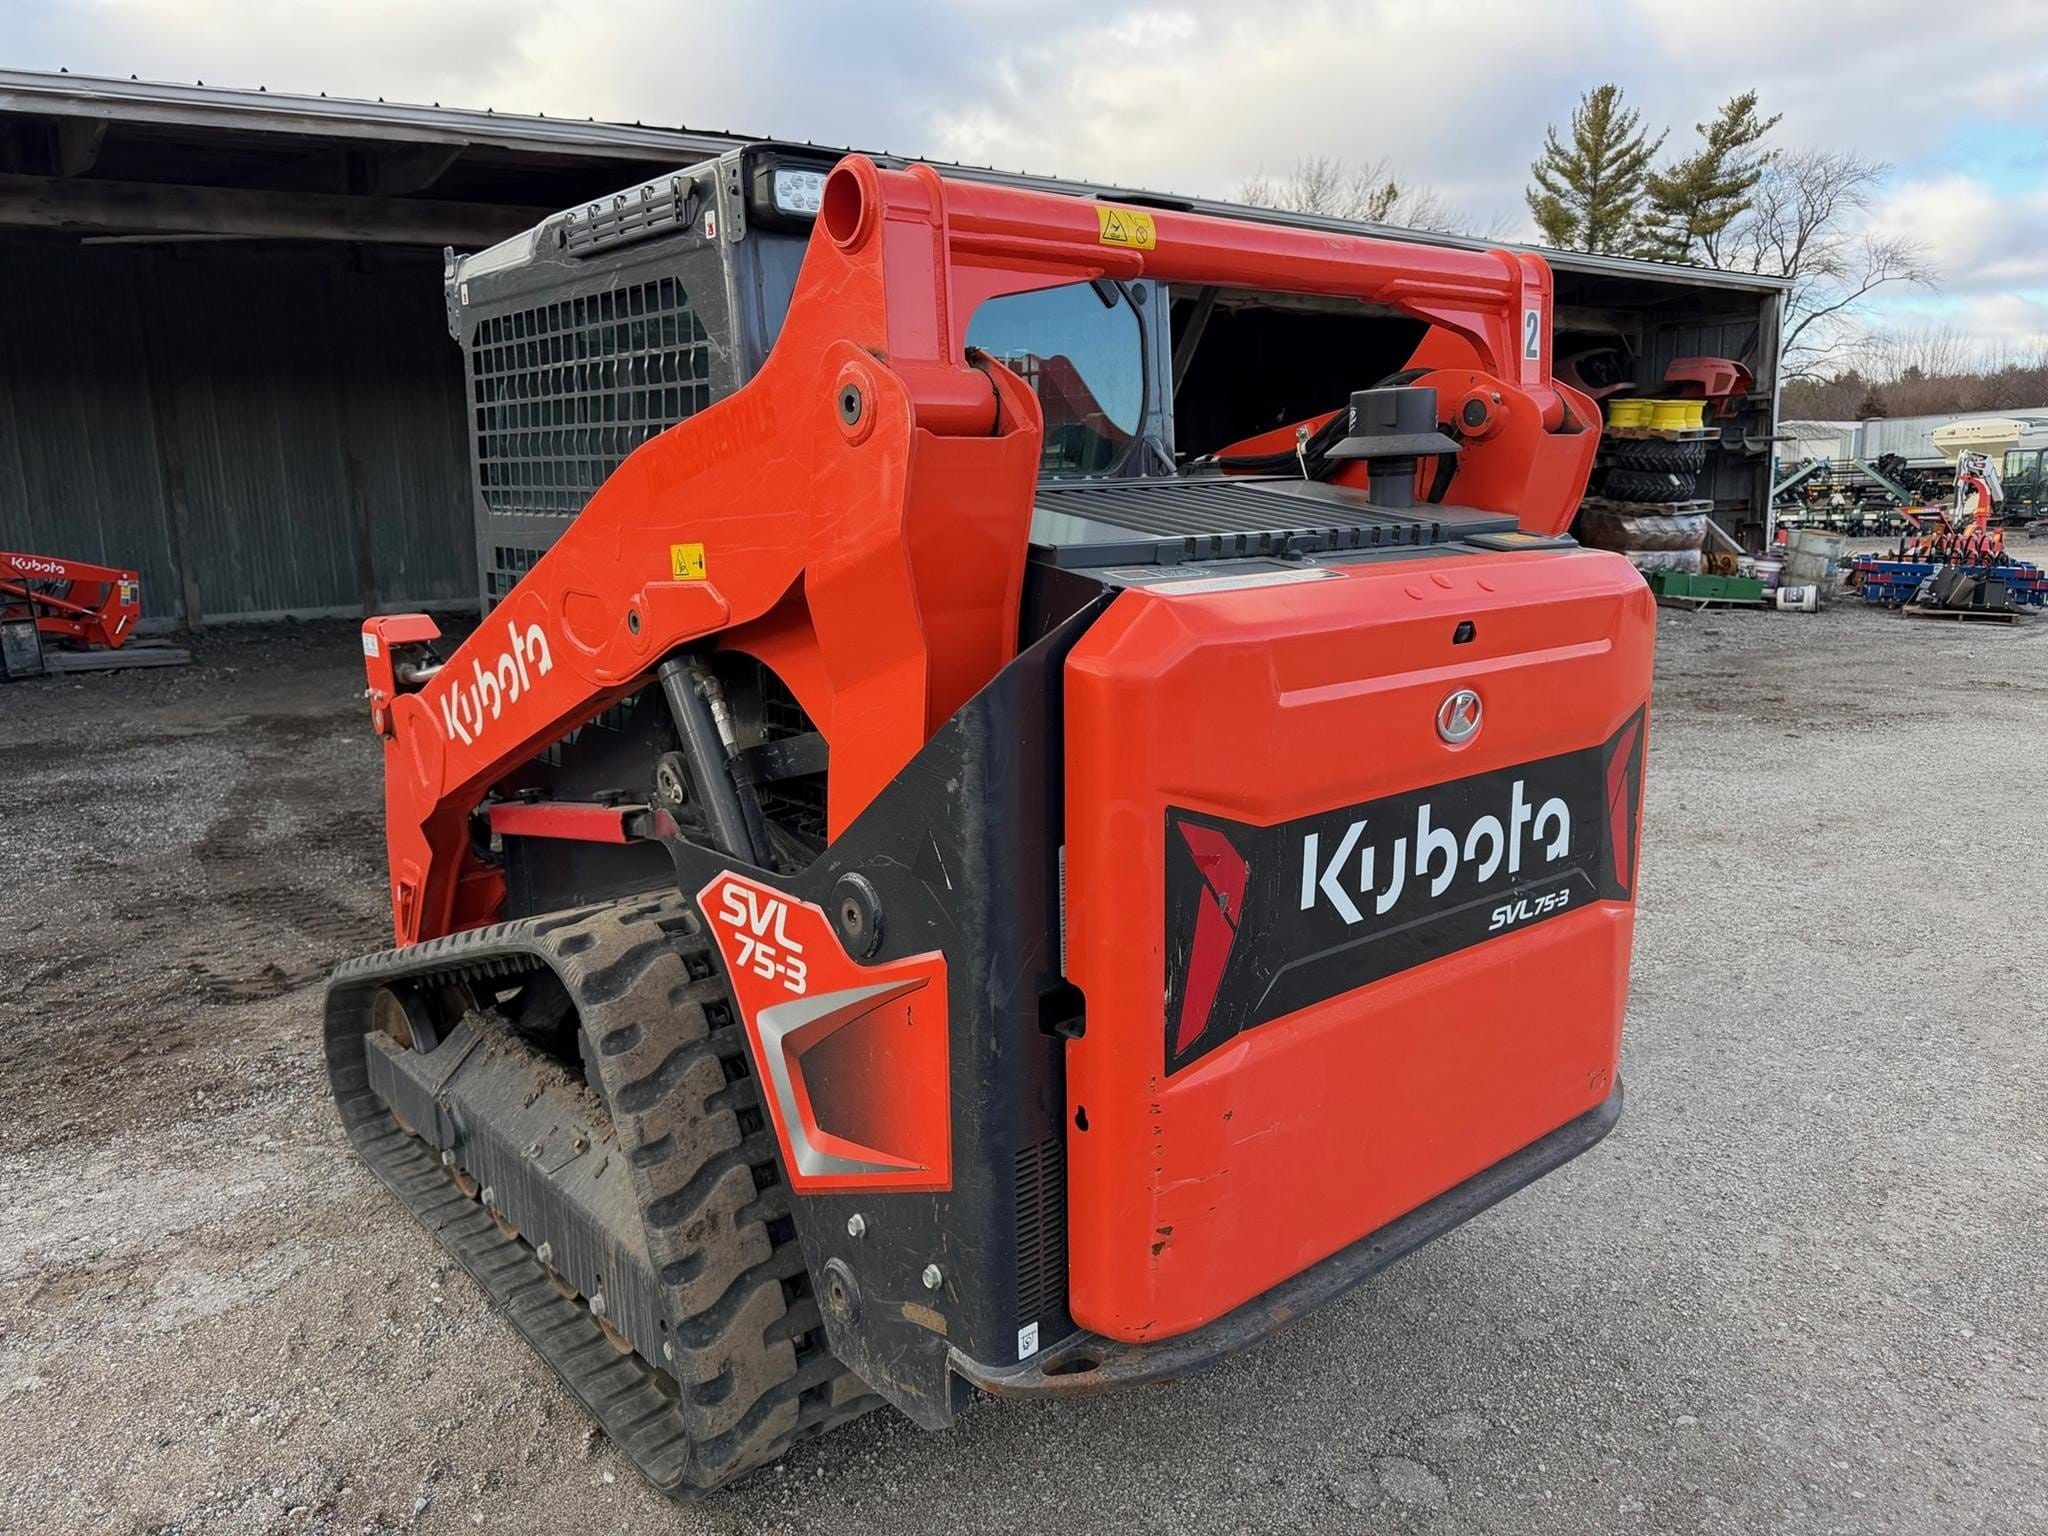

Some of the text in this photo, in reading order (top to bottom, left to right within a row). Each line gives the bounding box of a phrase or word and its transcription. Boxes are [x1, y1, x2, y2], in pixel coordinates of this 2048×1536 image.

[1525, 311, 1538, 358] 2
[11, 556, 65, 575] Kubota
[440, 619, 553, 746] Kubota
[1300, 779, 1571, 925] Kubota
[719, 882, 803, 954] SVL
[734, 932, 807, 995] 75-3
